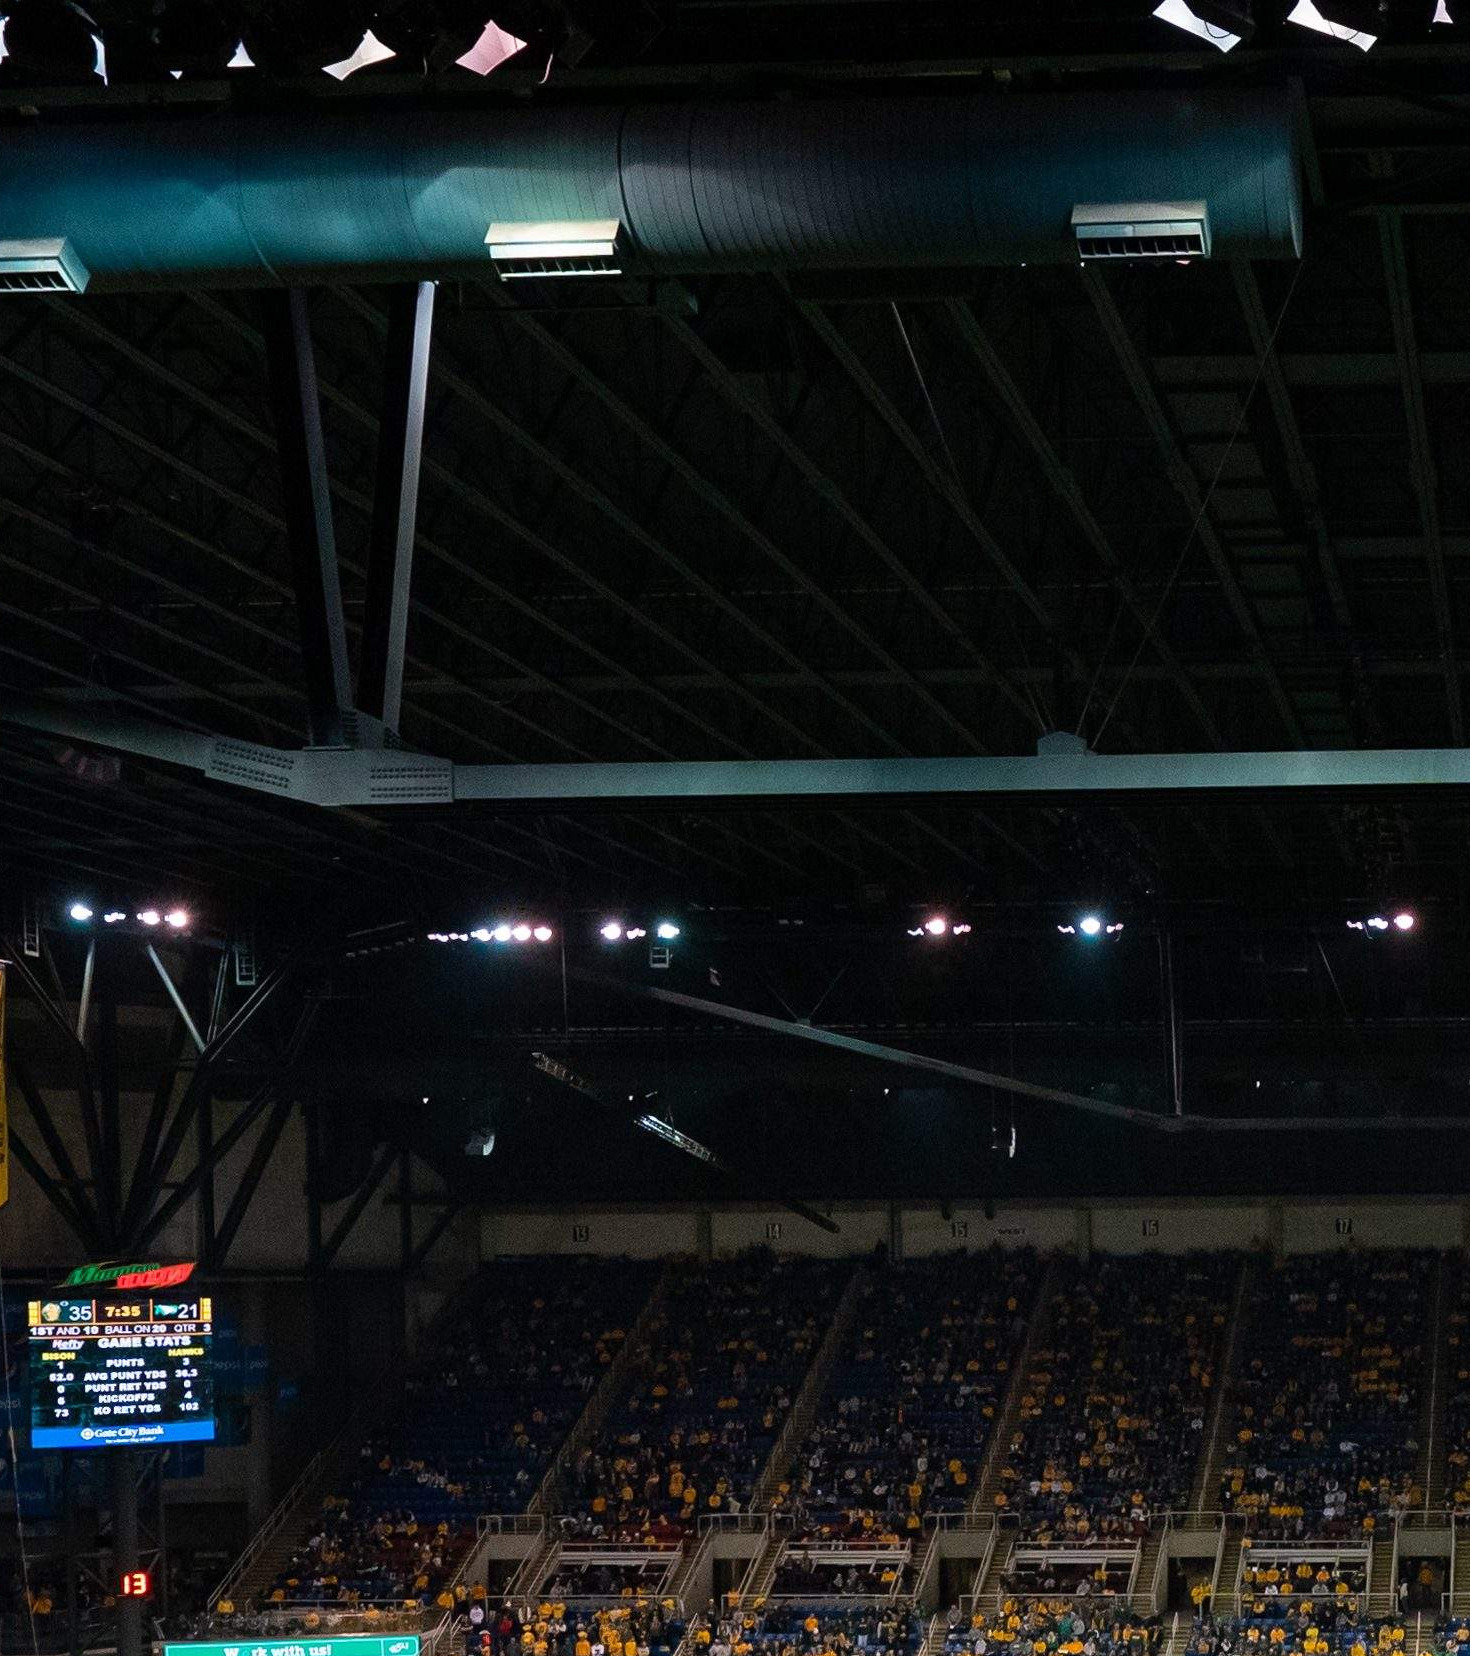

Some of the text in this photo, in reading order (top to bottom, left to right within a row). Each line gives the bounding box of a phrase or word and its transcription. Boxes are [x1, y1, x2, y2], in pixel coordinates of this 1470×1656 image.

[69, 1304, 198, 1321] 35 7:35 21
[145, 1336, 191, 1348] STATS
[124, 1572, 148, 1597] 13
